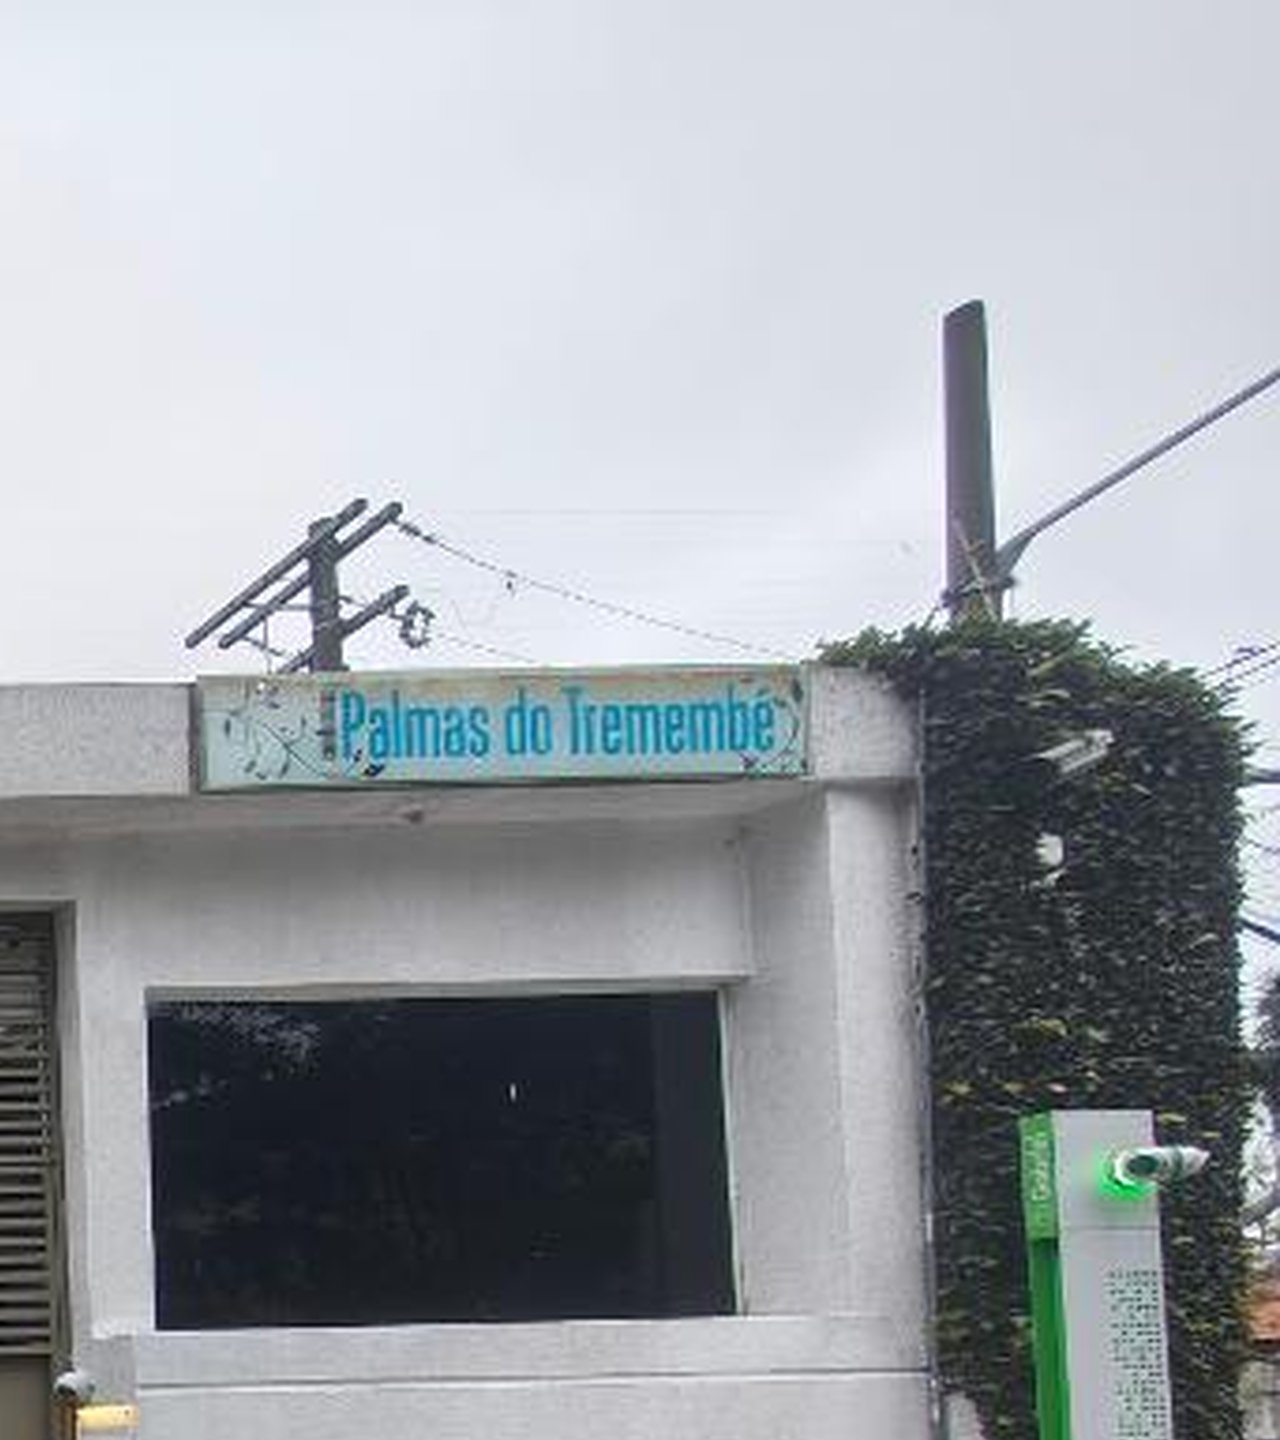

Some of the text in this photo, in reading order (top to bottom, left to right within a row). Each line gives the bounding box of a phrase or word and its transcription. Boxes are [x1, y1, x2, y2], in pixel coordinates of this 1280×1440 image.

[342, 690, 490, 760] Palmas
[506, 687, 553, 755] do
[561, 683, 775, 756] Tremembé
